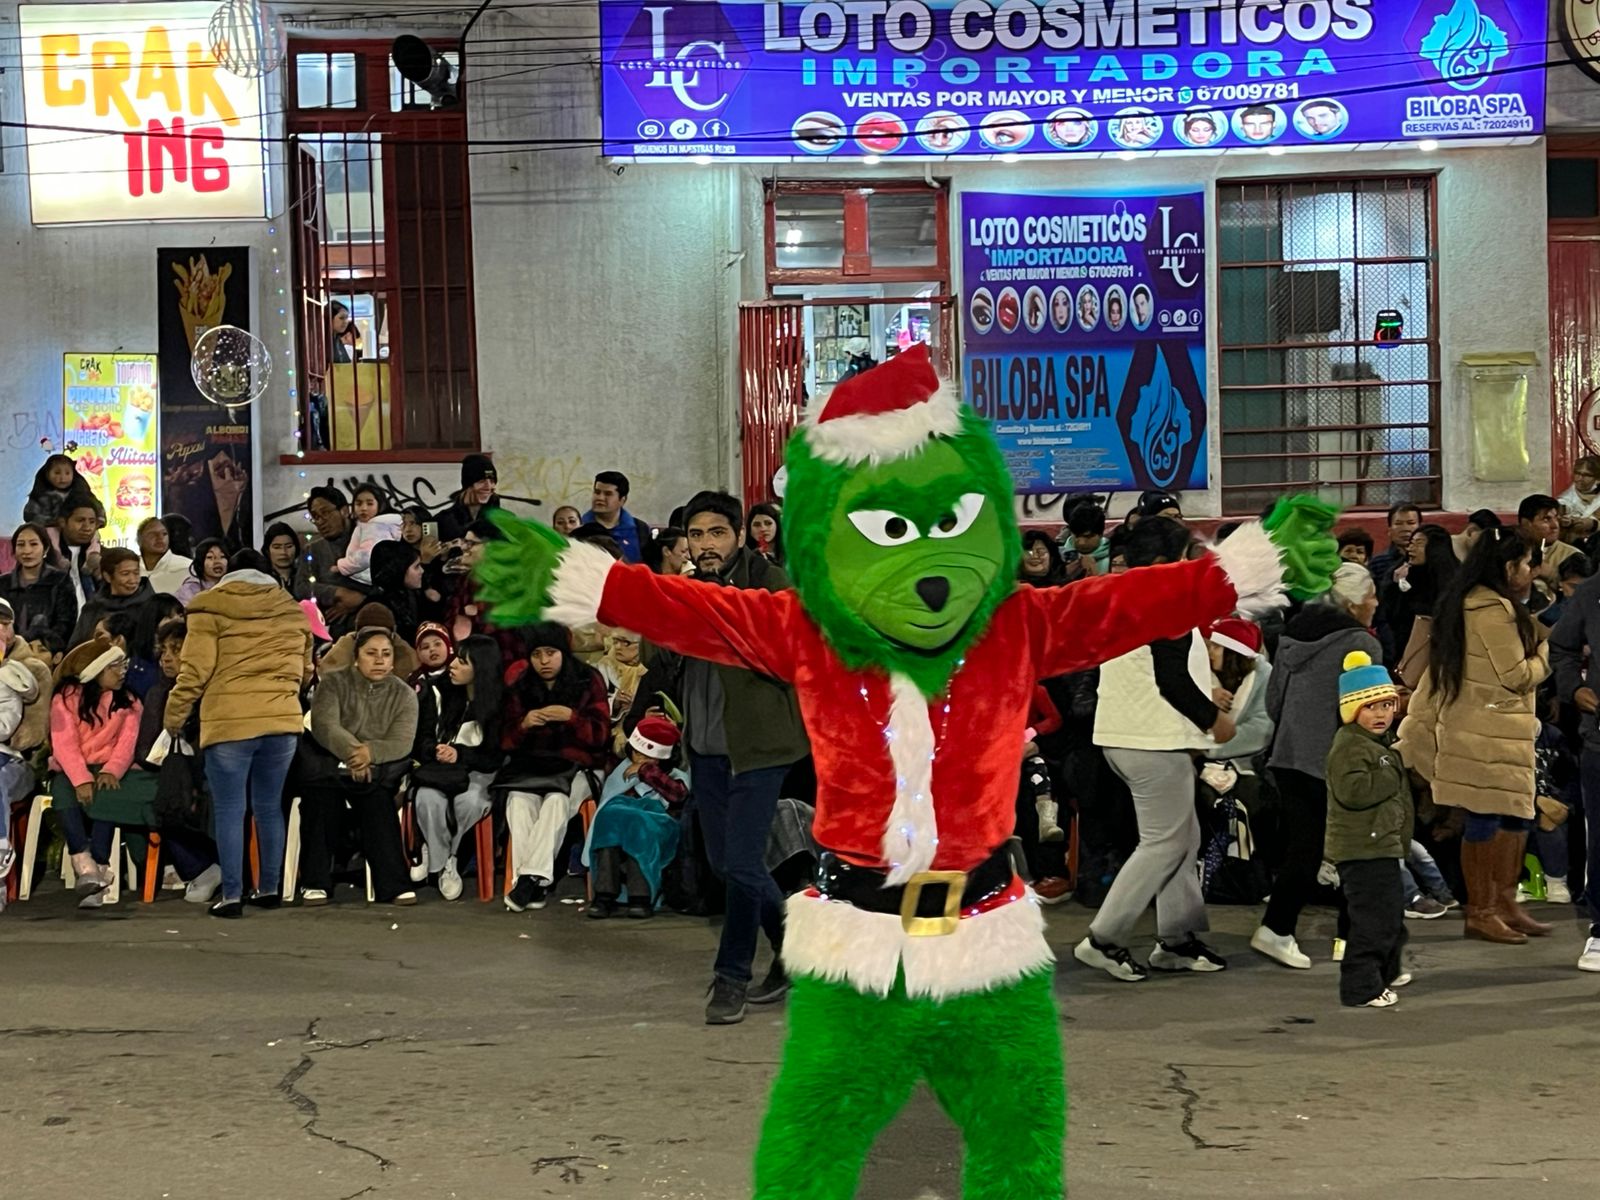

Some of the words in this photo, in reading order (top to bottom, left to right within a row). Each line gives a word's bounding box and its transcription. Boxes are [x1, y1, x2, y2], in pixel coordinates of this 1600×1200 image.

[763, 0, 932, 51] LOTO
[950, 0, 1374, 50] COSMETICOS
[40, 25, 241, 127] CRAK
[802, 48, 1338, 86] IMPORTADORA
[842, 91, 931, 108] VENTAS
[937, 90, 983, 107] POR
[988, 89, 1067, 106] MAYOR
[1071, 89, 1088, 105] Y
[1093, 87, 1174, 104] MENOR
[1197, 82, 1299, 101] 67009781
[1409, 98, 1481, 117] BILOBA
[1485, 97, 1523, 115] SPA
[1405, 121, 1459, 133] RESERVAS
[1482, 118, 1531, 130] 72024911
[970, 216, 1020, 247] LOTO
[1023, 213, 1148, 246] COSMETICOS
[990, 246, 1128, 268] IMPORTADORA
[986, 268, 1012, 281] VENTAS
[1012, 268, 1027, 281] POR
[1027, 267, 1050, 280] MAYOR
[1050, 267, 1056, 280] Y
[1056, 266, 1081, 279] MENOR
[1088, 265, 1134, 278] 67009781
[80, 357, 102, 373] CRAK
[971, 355, 1060, 421] BILOBA
[1065, 354, 1112, 420] SPA
[106, 447, 157, 465] Alitas
